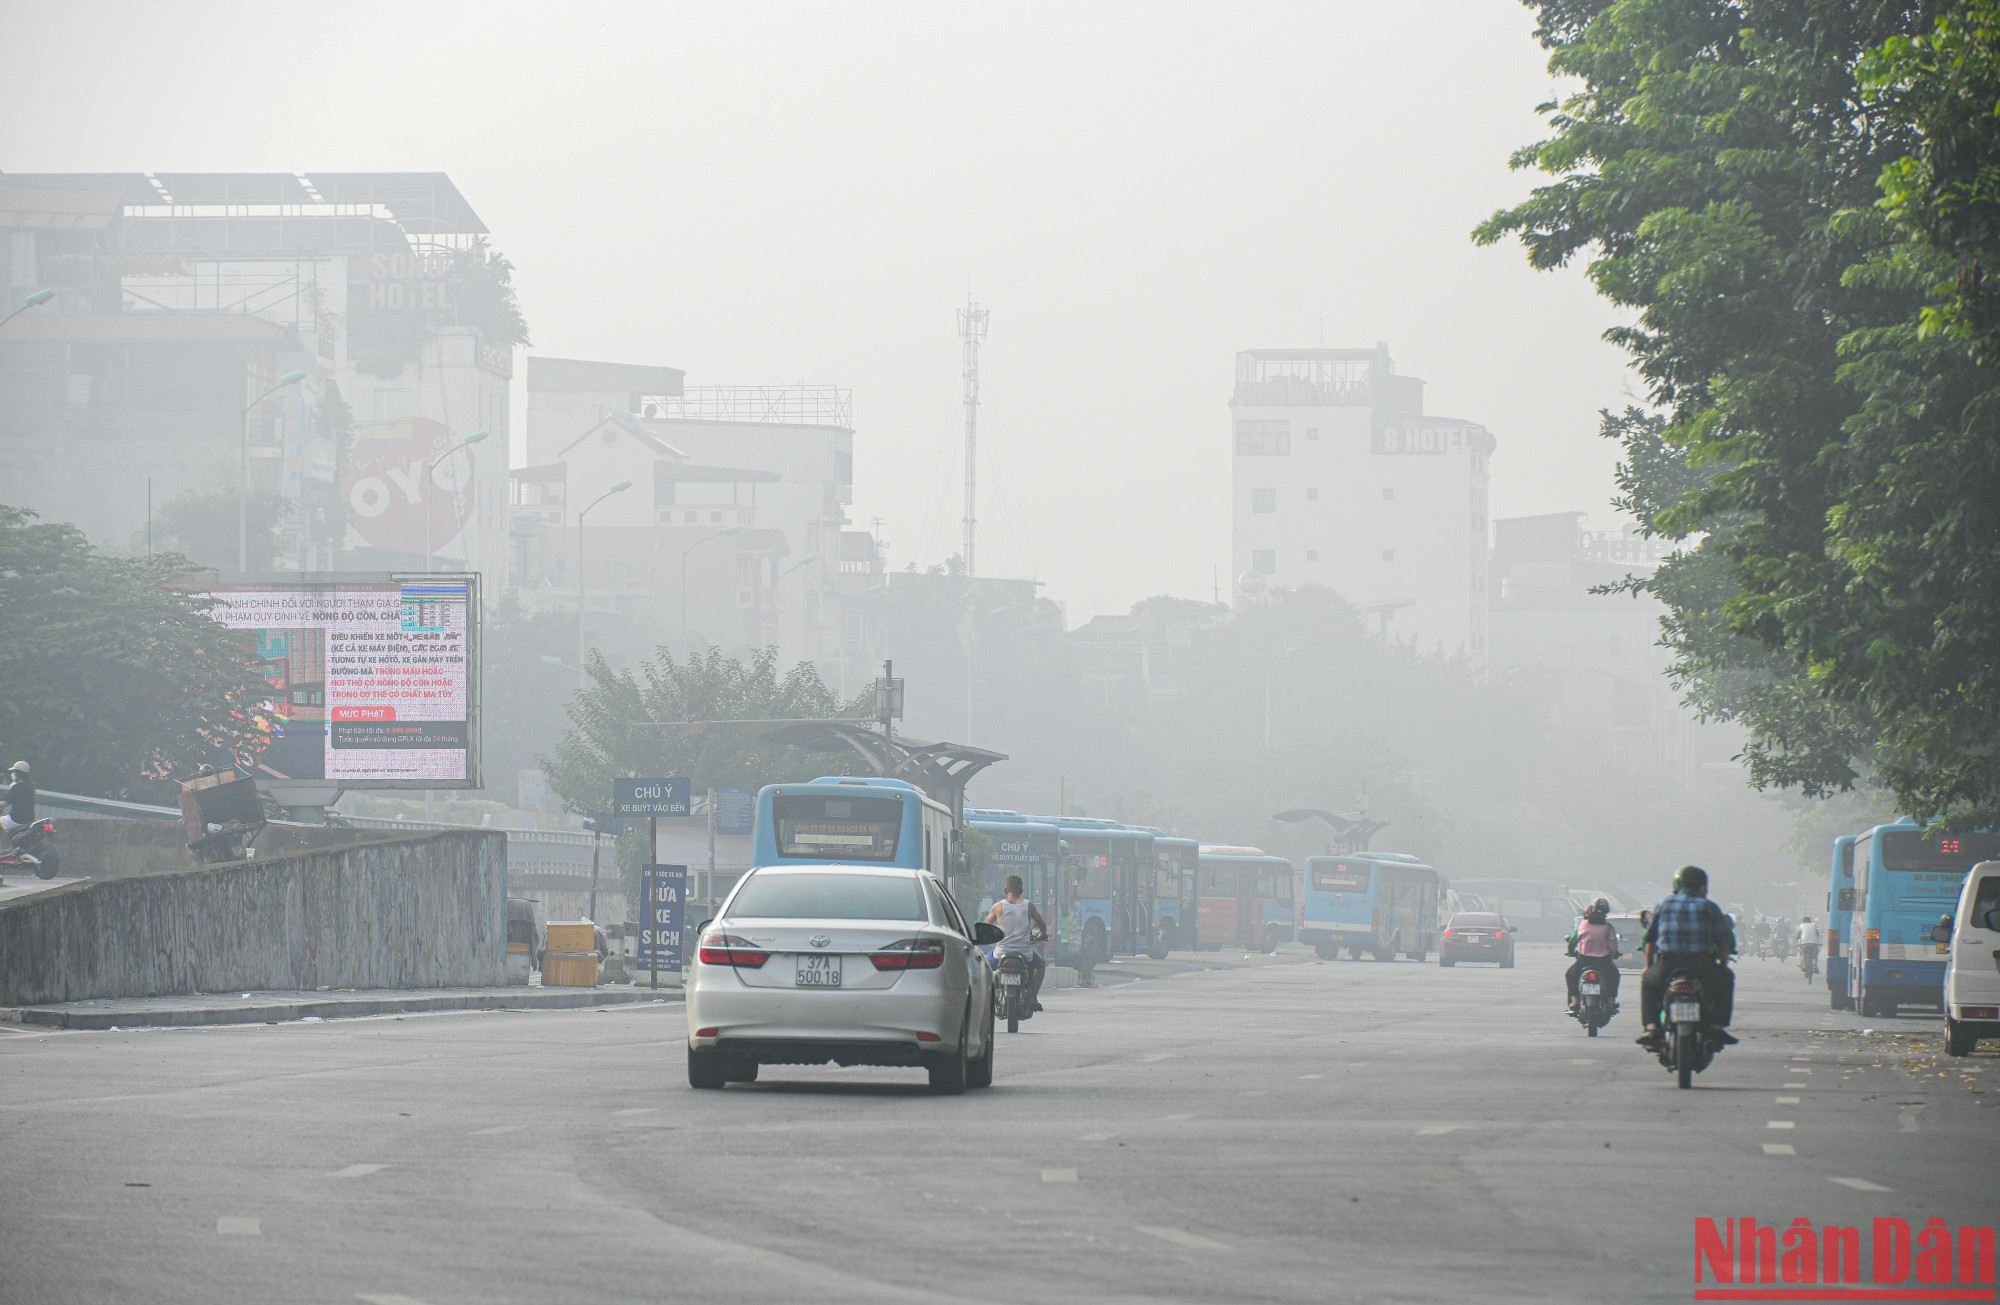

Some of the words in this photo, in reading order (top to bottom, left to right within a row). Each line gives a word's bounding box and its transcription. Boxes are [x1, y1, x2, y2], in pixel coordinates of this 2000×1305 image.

[372, 252, 445, 279] SOHO
[368, 282, 450, 309] HOTEL
[1385, 428, 1399, 451] B
[1406, 427, 1472, 451] HOTEL
[350, 450, 472, 517] OYO
[341, 610, 354, 623] ĐỘ
[375, 667, 401, 675] TRONG
[331, 690, 358, 698] TRONG
[339, 709, 359, 718] MỨC
[361, 709, 385, 719] PHẠT
[634, 784, 661, 799] CHÚ
[664, 784, 673, 798] Ý
[620, 804, 631, 812] XE
[632, 802, 651, 812] BUÝT
[652, 802, 668, 812] VÀO
[670, 801, 685, 812] BẾN
[1001, 841, 1020, 851] CHÚ
[1022, 841, 1029, 851] Ý
[642, 929, 679, 946] SCH
[807, 957, 830, 969] 37A
[798, 970, 839, 984] 500.18
